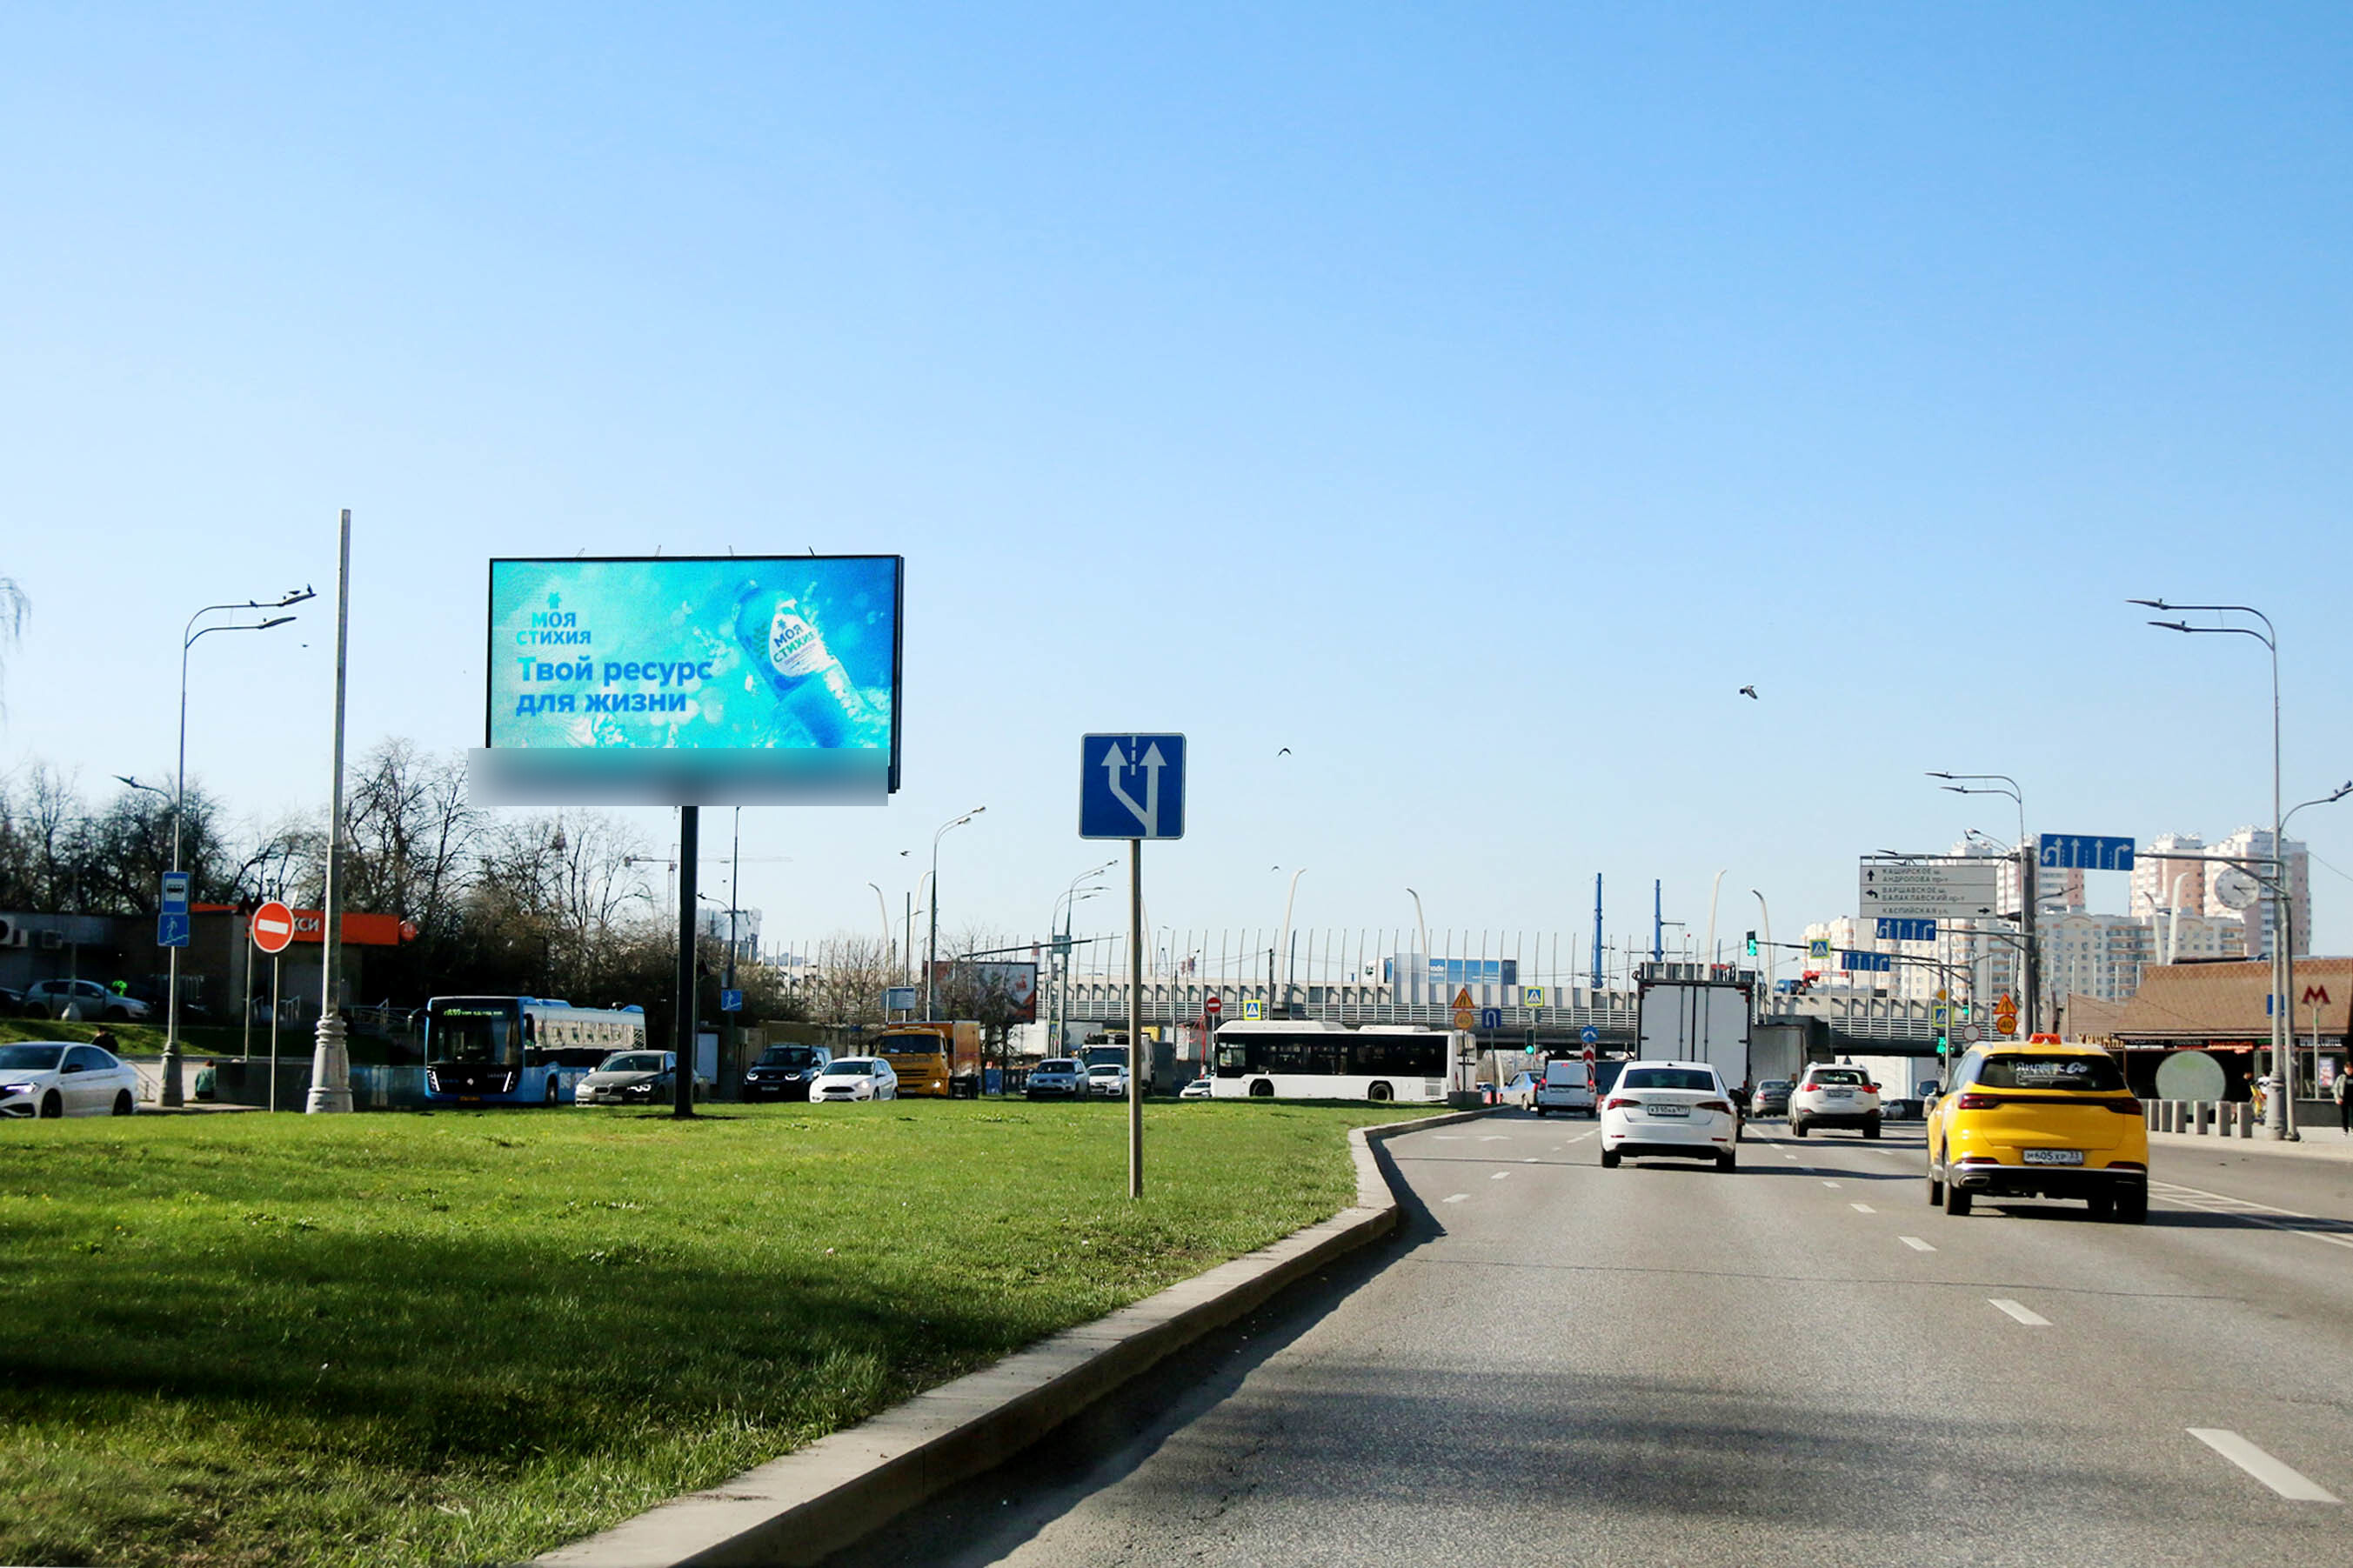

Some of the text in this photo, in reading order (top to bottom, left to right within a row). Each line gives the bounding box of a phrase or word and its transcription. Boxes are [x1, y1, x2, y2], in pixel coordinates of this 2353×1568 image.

[531, 611, 576, 628] МОЯ
[516, 631, 591, 646] СТИХИЯ
[773, 624, 803, 648] МОЯ
[517, 655, 713, 687] Твой ресурс
[516, 693, 686, 717] для жизни
[2302, 984, 2331, 1004] М
[2000, 1020, 2013, 1030] 40
[2066, 1062, 2088, 1074] Go
